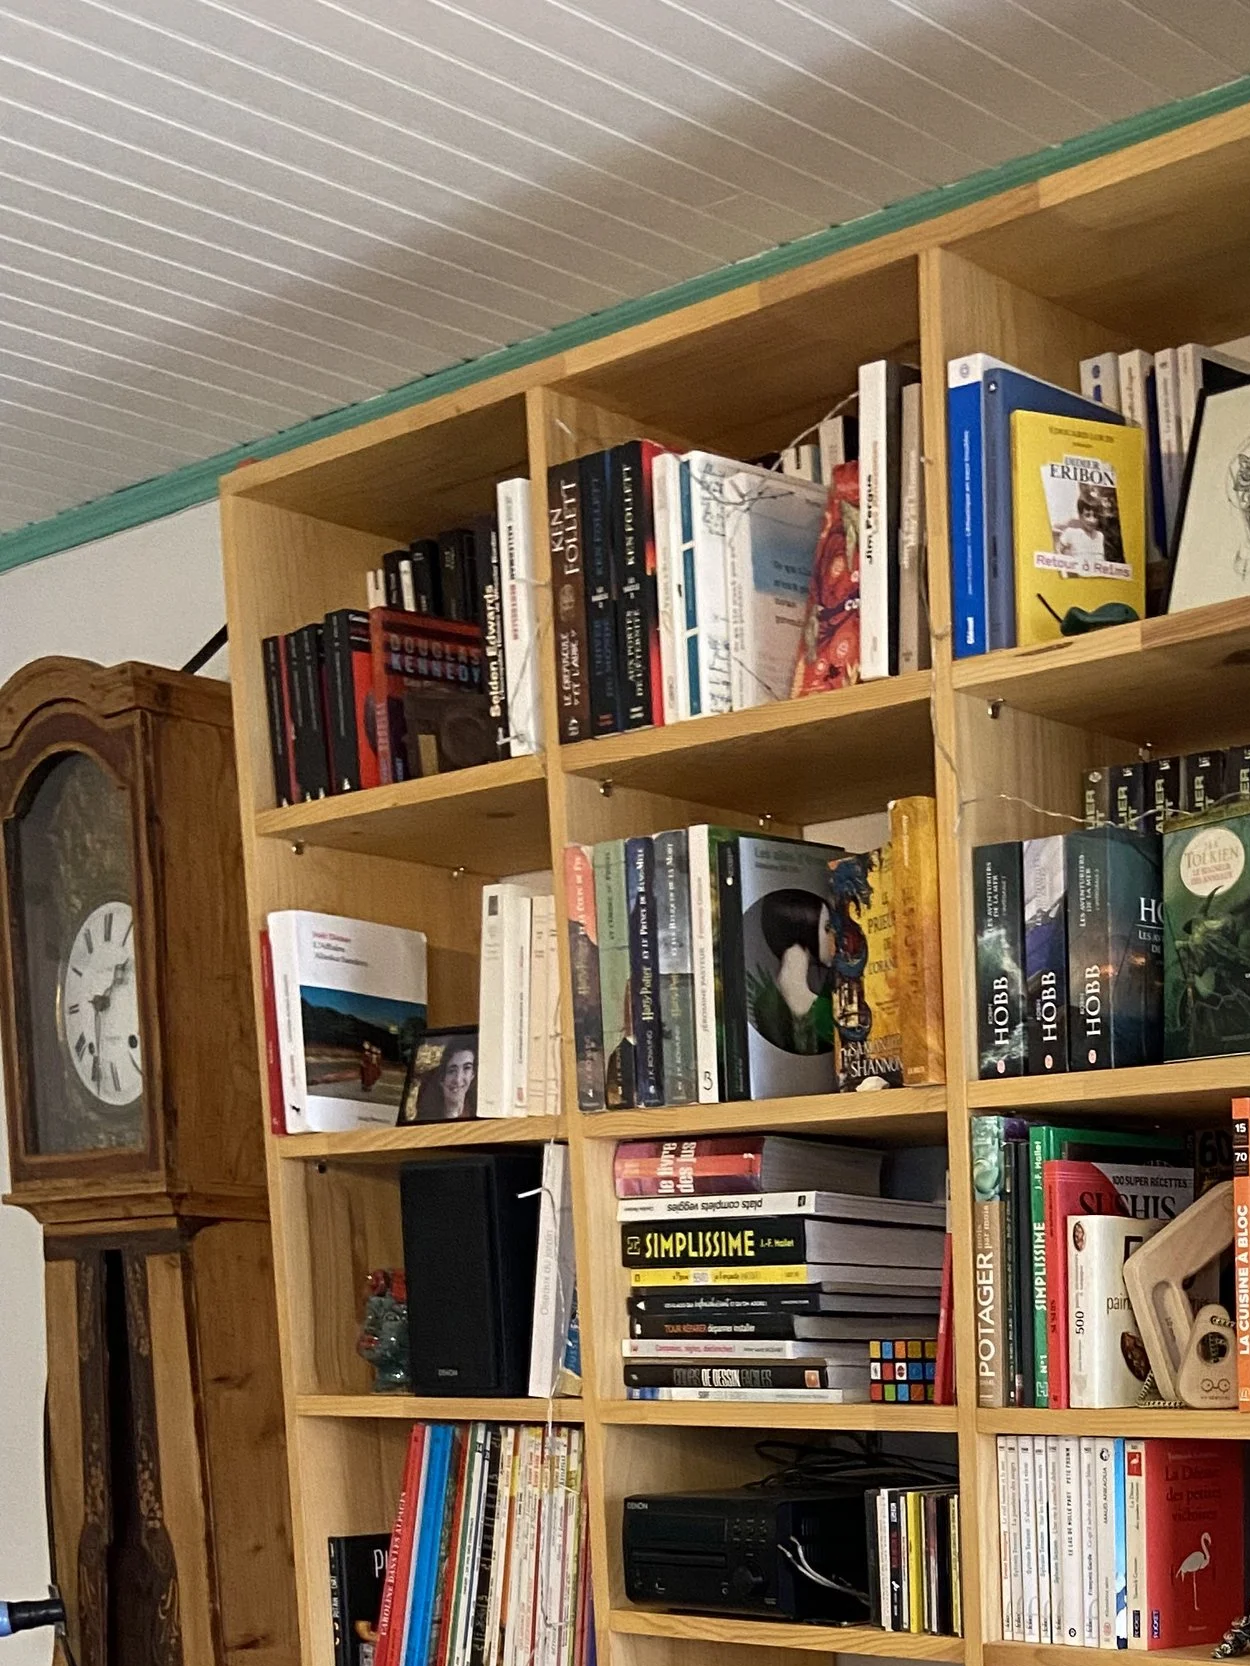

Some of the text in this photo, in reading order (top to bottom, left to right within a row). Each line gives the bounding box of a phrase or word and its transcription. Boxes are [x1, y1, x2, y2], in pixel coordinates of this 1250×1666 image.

[1049, 463, 1116, 486] ERIBON
[550, 508, 564, 553] KEN
[560, 479, 580, 576] FOLLETT
[1036, 554, 1131, 578] Retour à Reims
[389, 633, 481, 665] DOUGLAS
[483, 584, 501, 718] Selden Edwards
[391, 652, 480, 683] KENNEDY
[1184, 846, 1239, 870] TOLKIEN
[993, 976, 1009, 1045] HOBB
[1041, 971, 1057, 1041] HOBB
[1084, 963, 1101, 1036] HOBB
[1235, 1123, 1247, 1133] 15
[656, 1142, 677, 1194] le livre
[676, 1141, 697, 1193] des jus
[1234, 1152, 1247, 1162] 70
[1125, 1176, 1149, 1187] SUPER
[667, 1198, 763, 1214] plats complets veggies
[982, 1205, 992, 1249] par mois
[645, 1230, 755, 1258] SIMPLISSIME
[1033, 1221, 1047, 1311] SIMPLISSIME
[1234, 1204, 1250, 1355] LA CUISINE À BLOC
[976, 1252, 995, 1377] POTAGER
[1075, 1311, 1085, 1335] 500
[712, 1368, 741, 1387] DESSIN
[627, 1502, 648, 1510] DENON
